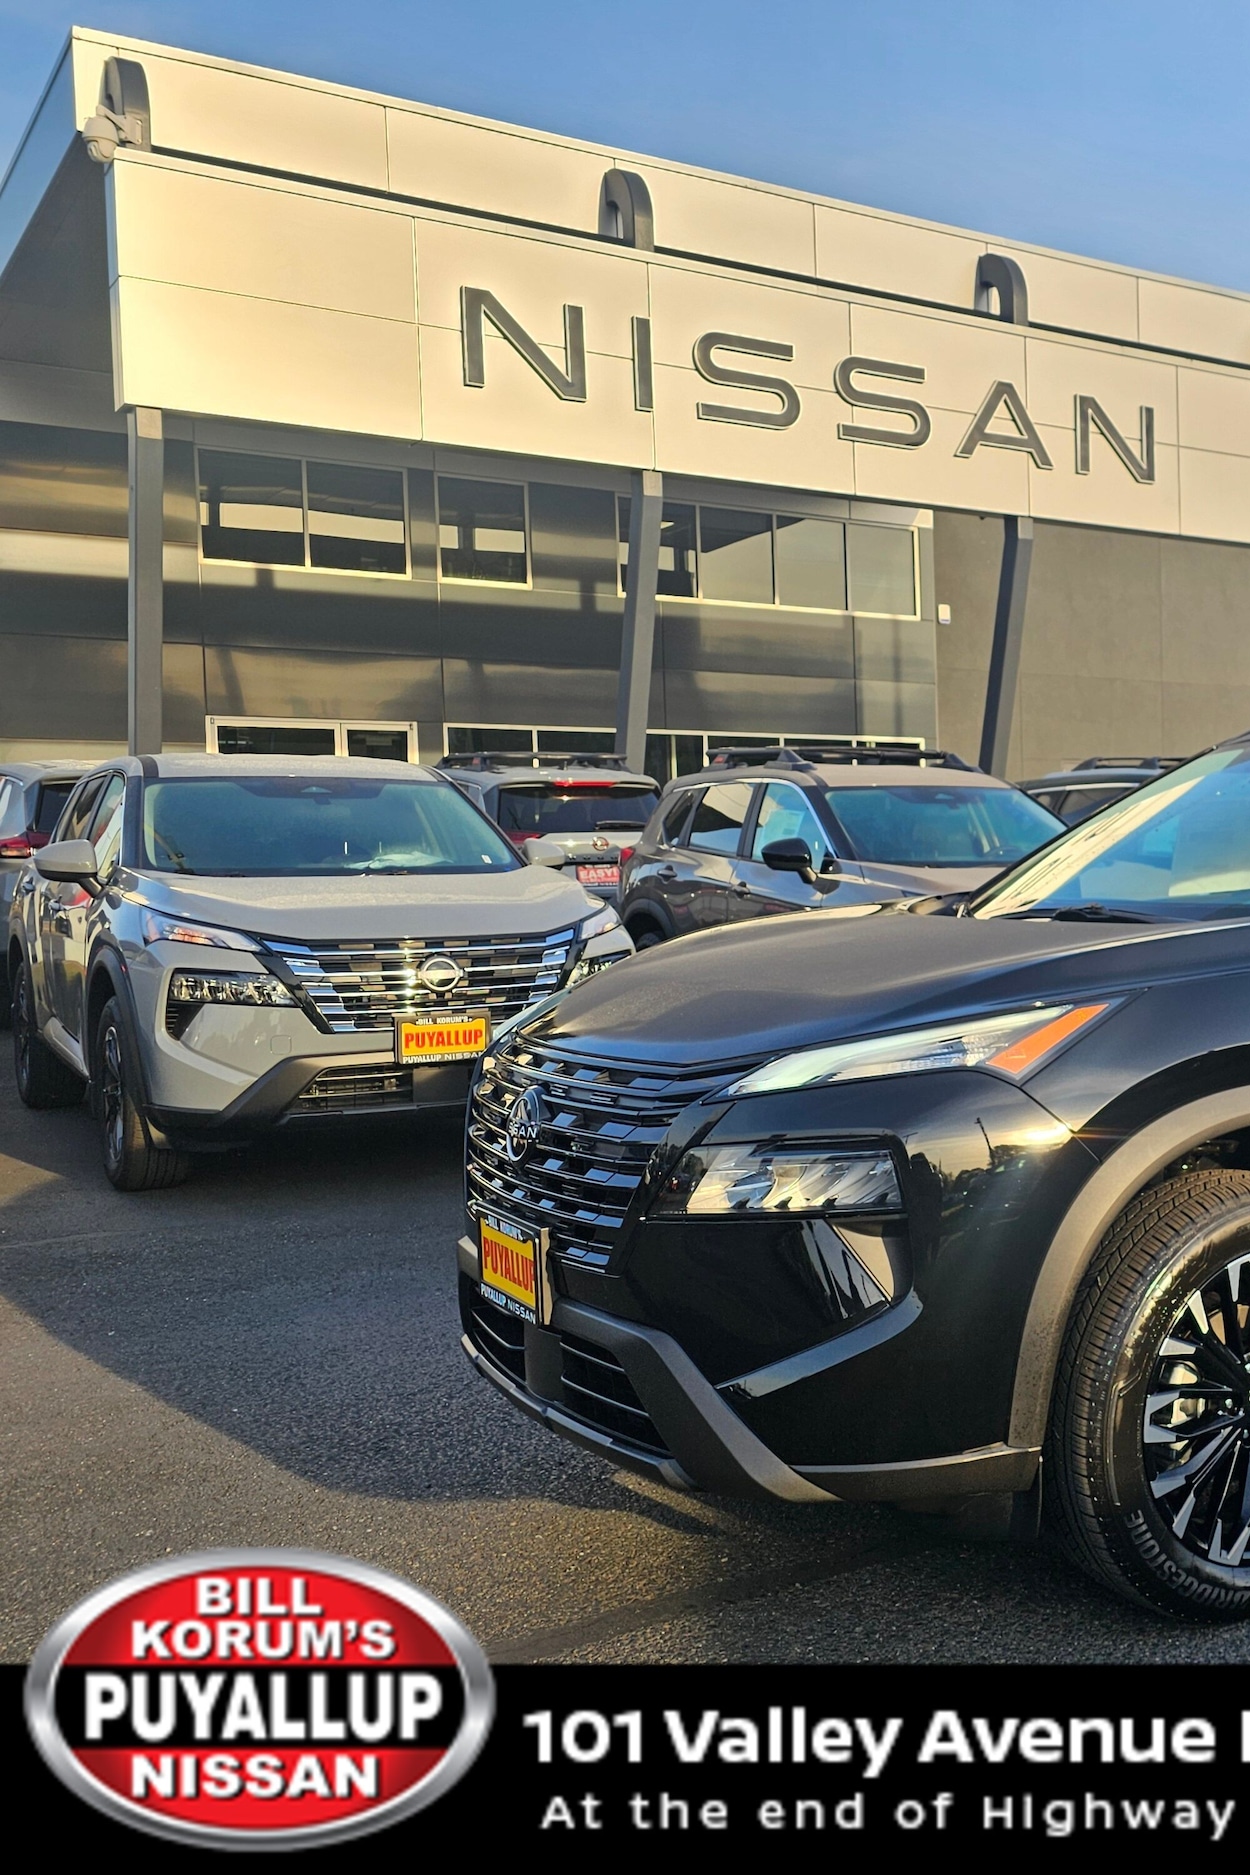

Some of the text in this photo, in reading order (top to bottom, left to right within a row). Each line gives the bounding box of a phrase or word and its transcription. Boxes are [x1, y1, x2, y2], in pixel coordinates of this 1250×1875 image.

[460, 285, 1155, 485] NISSAN
[404, 1028, 484, 1050] PUYALLUP
[402, 1053, 442, 1065] PUYALLUP
[507, 1299, 537, 1326] NISSAN
